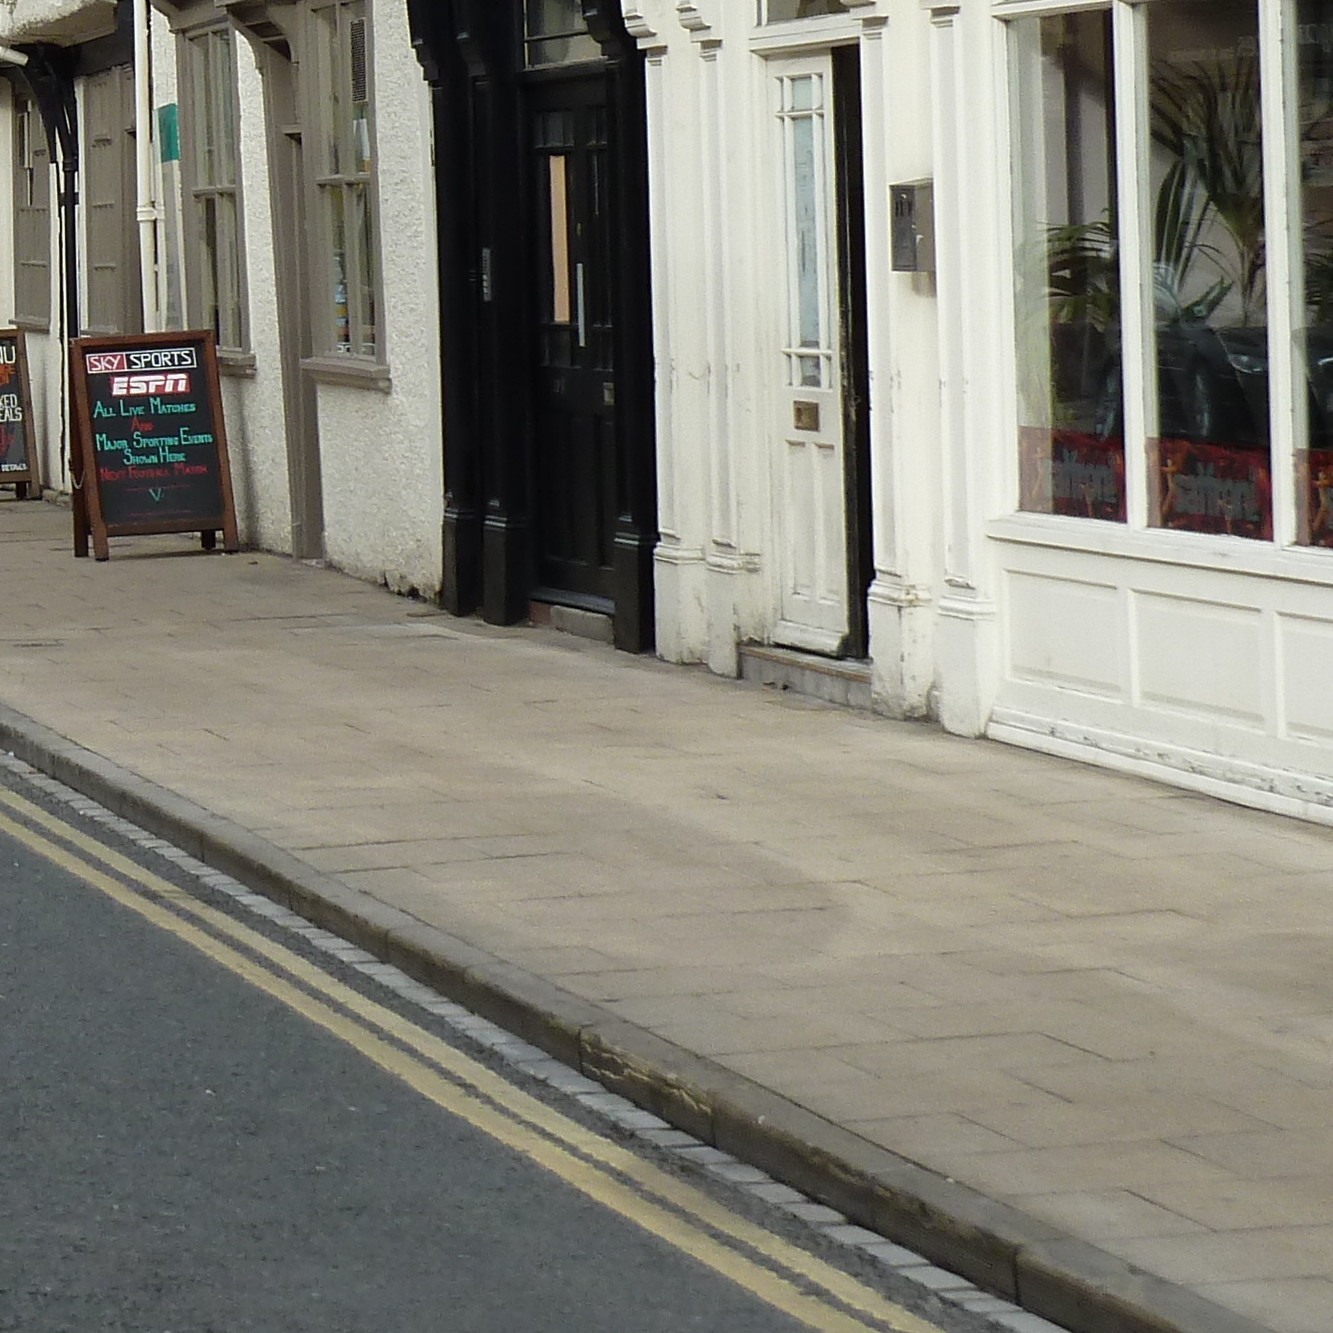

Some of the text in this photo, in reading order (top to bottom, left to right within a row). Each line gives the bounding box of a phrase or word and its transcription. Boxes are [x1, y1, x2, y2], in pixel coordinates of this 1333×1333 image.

[89, 350, 192, 371] SKY SPORTS
[112, 373, 187, 396] ESPN
